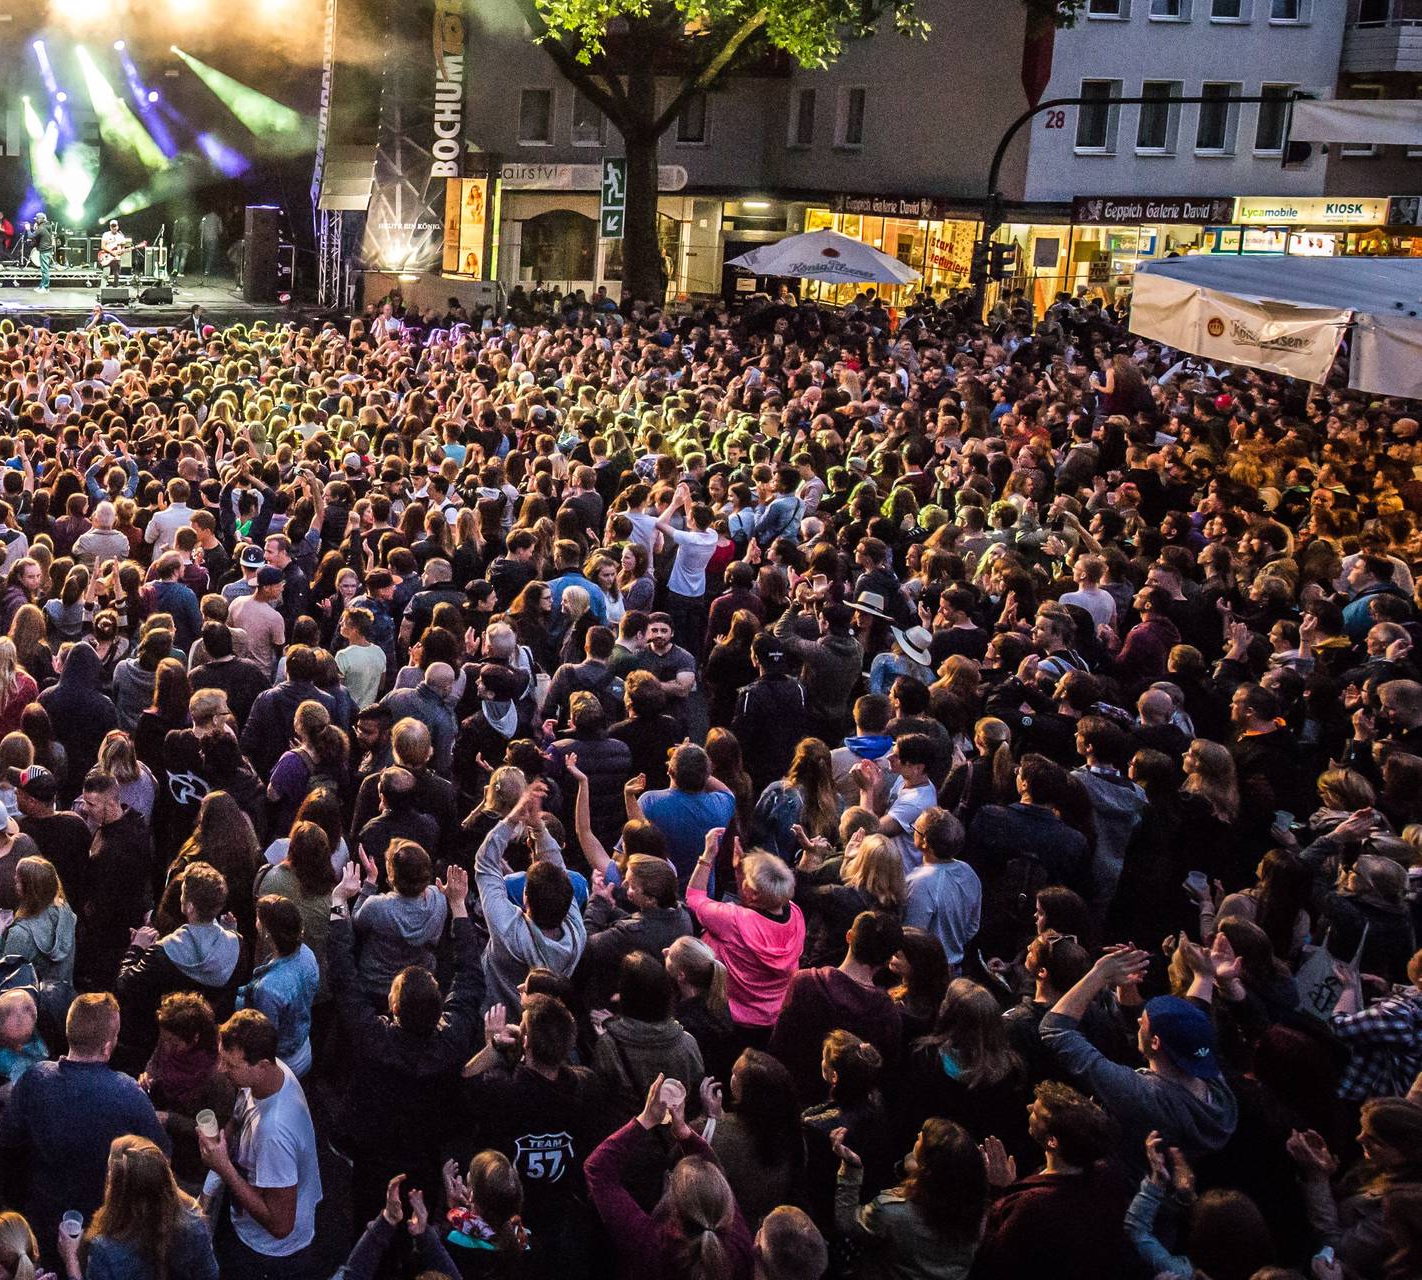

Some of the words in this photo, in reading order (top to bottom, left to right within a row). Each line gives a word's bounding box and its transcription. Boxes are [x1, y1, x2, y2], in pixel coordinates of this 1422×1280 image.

[432, 55, 464, 177] BOCHUM
[1045, 110, 1066, 129] 28
[872, 198, 897, 213] Galerie
[899, 200, 920, 215] David
[1146, 202, 1180, 219] Galerie
[1183, 202, 1210, 219] David
[1241, 207, 1298, 219] Lycamobile
[1325, 203, 1363, 214] KIOSK
[930, 237, 954, 254] stark
[930, 252, 969, 277] reduziert
[529, 1139, 563, 1148] TEAM
[527, 1150, 563, 1179] 57
